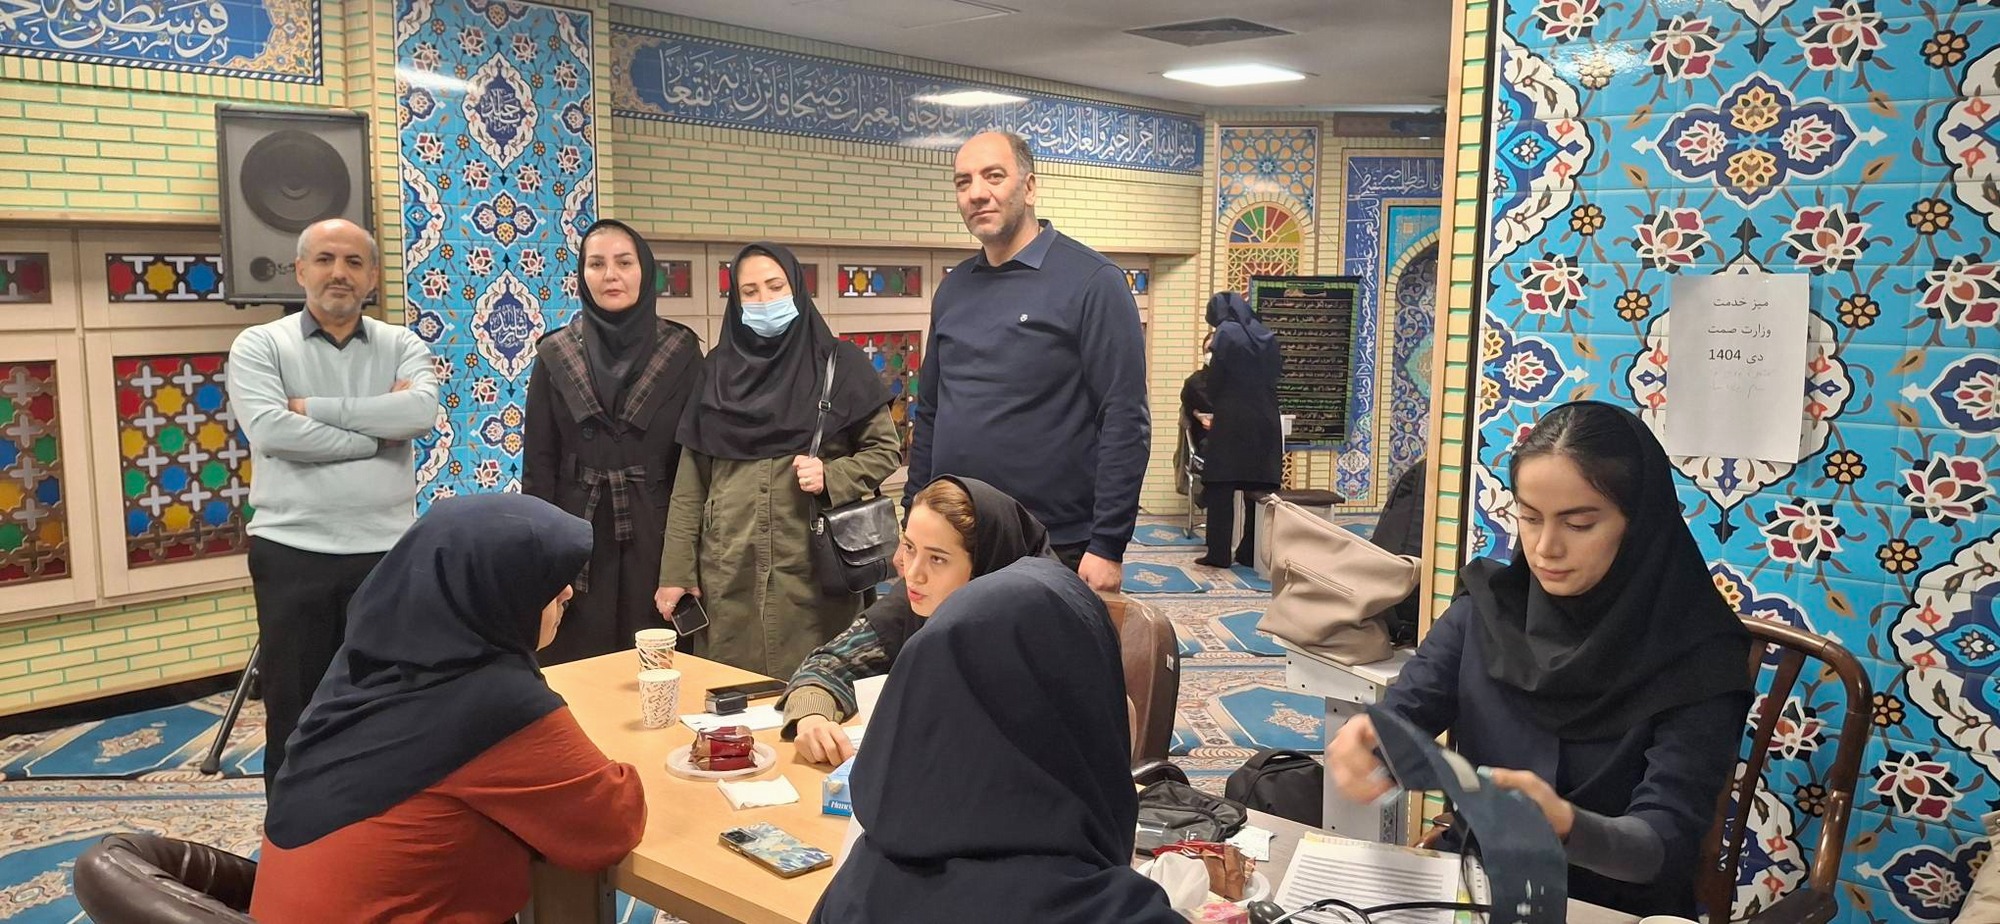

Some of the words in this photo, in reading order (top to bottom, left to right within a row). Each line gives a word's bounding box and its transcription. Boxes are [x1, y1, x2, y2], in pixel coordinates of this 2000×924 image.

[1713, 297, 1747, 308] خدمت
[1751, 297, 1769, 311] میز
[1707, 325, 1737, 335] صمت
[1740, 323, 1772, 338] وزارت
[1709, 348, 1741, 361] 1404
[1746, 353, 1764, 365] دی
